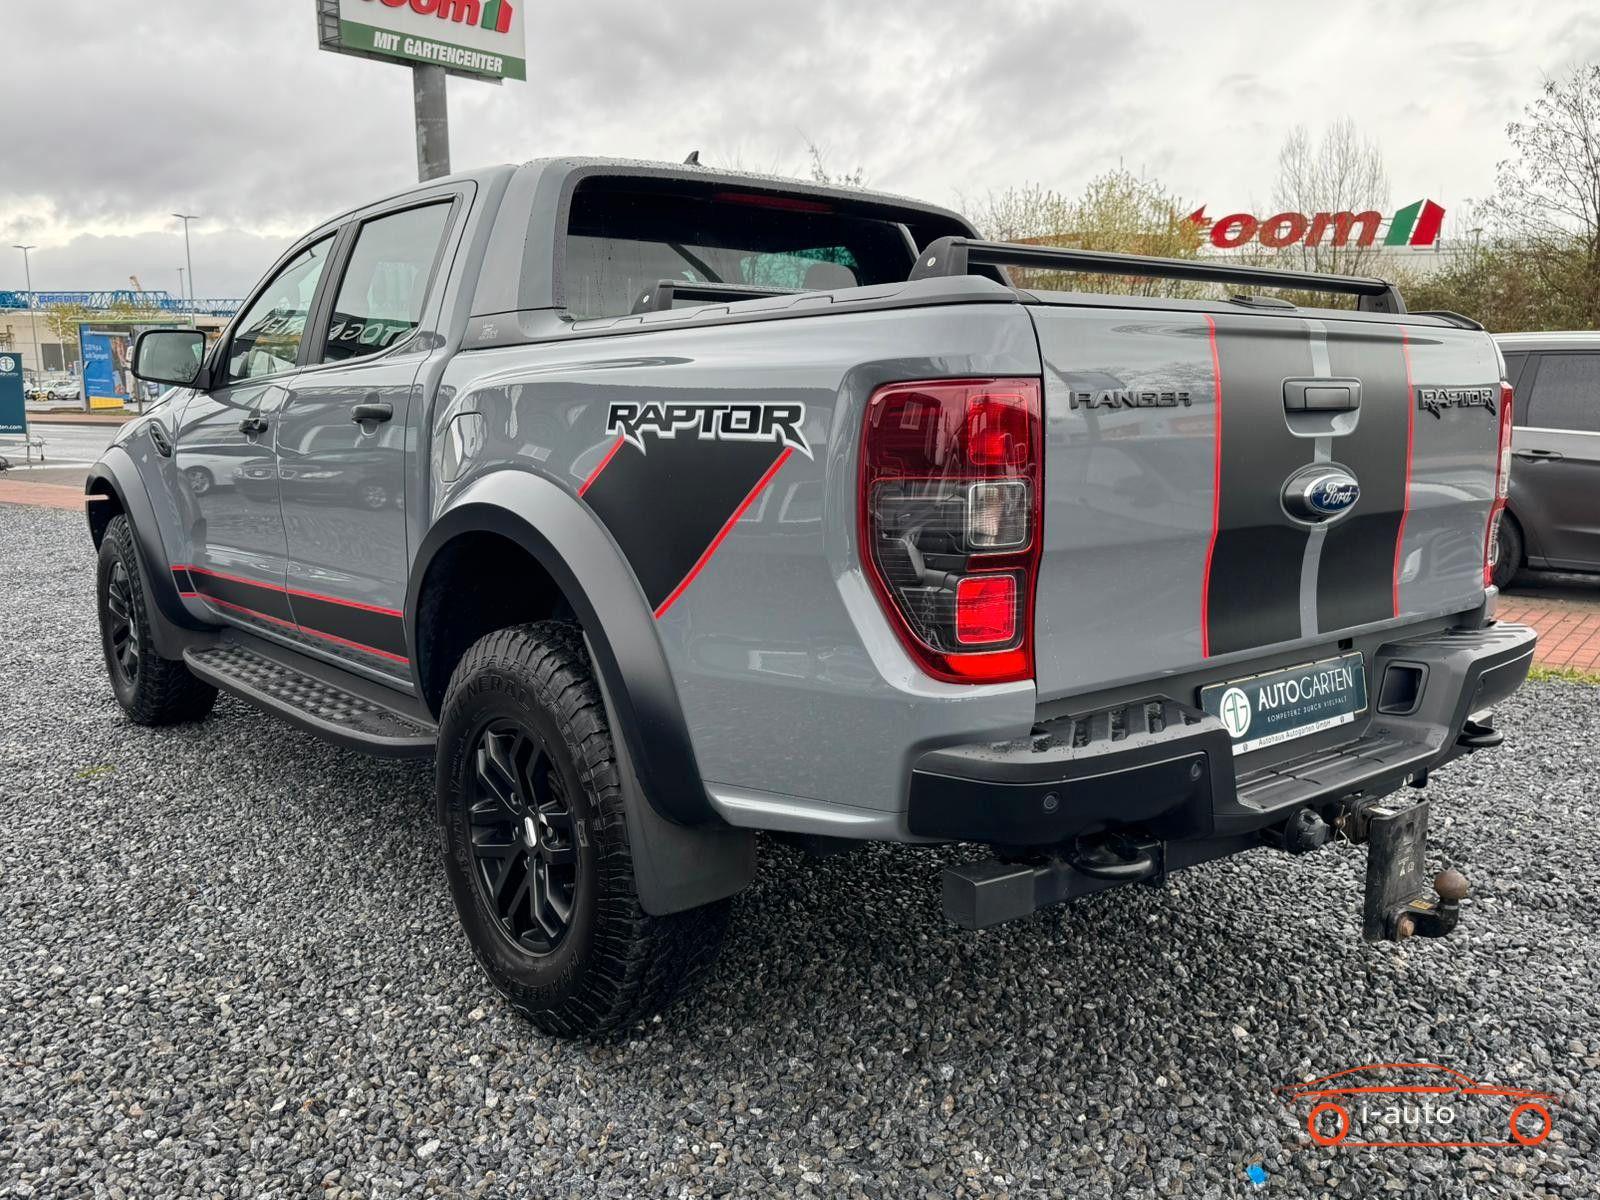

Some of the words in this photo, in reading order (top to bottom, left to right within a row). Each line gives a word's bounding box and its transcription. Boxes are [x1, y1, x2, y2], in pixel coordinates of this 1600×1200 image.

[373, 31, 401, 51] MIT
[403, 38, 503, 73] GARTENCENTER
[1069, 391, 1192, 410] RANGER
[1418, 388, 1497, 419] RAPTOR
[605, 401, 814, 461] RAPTOR
[1323, 481, 1353, 506] Ford
[1258, 666, 1354, 712] AUTOGARTEN
[1267, 708, 1301, 723] KOMPETENZ
[1303, 702, 1322, 714] DURCH
[1323, 695, 1348, 708] VIELFALT
[1258, 733, 1285, 747] Autohaus
[1285, 724, 1315, 738] Autogarten
[1315, 719, 1331, 731] GmbH
